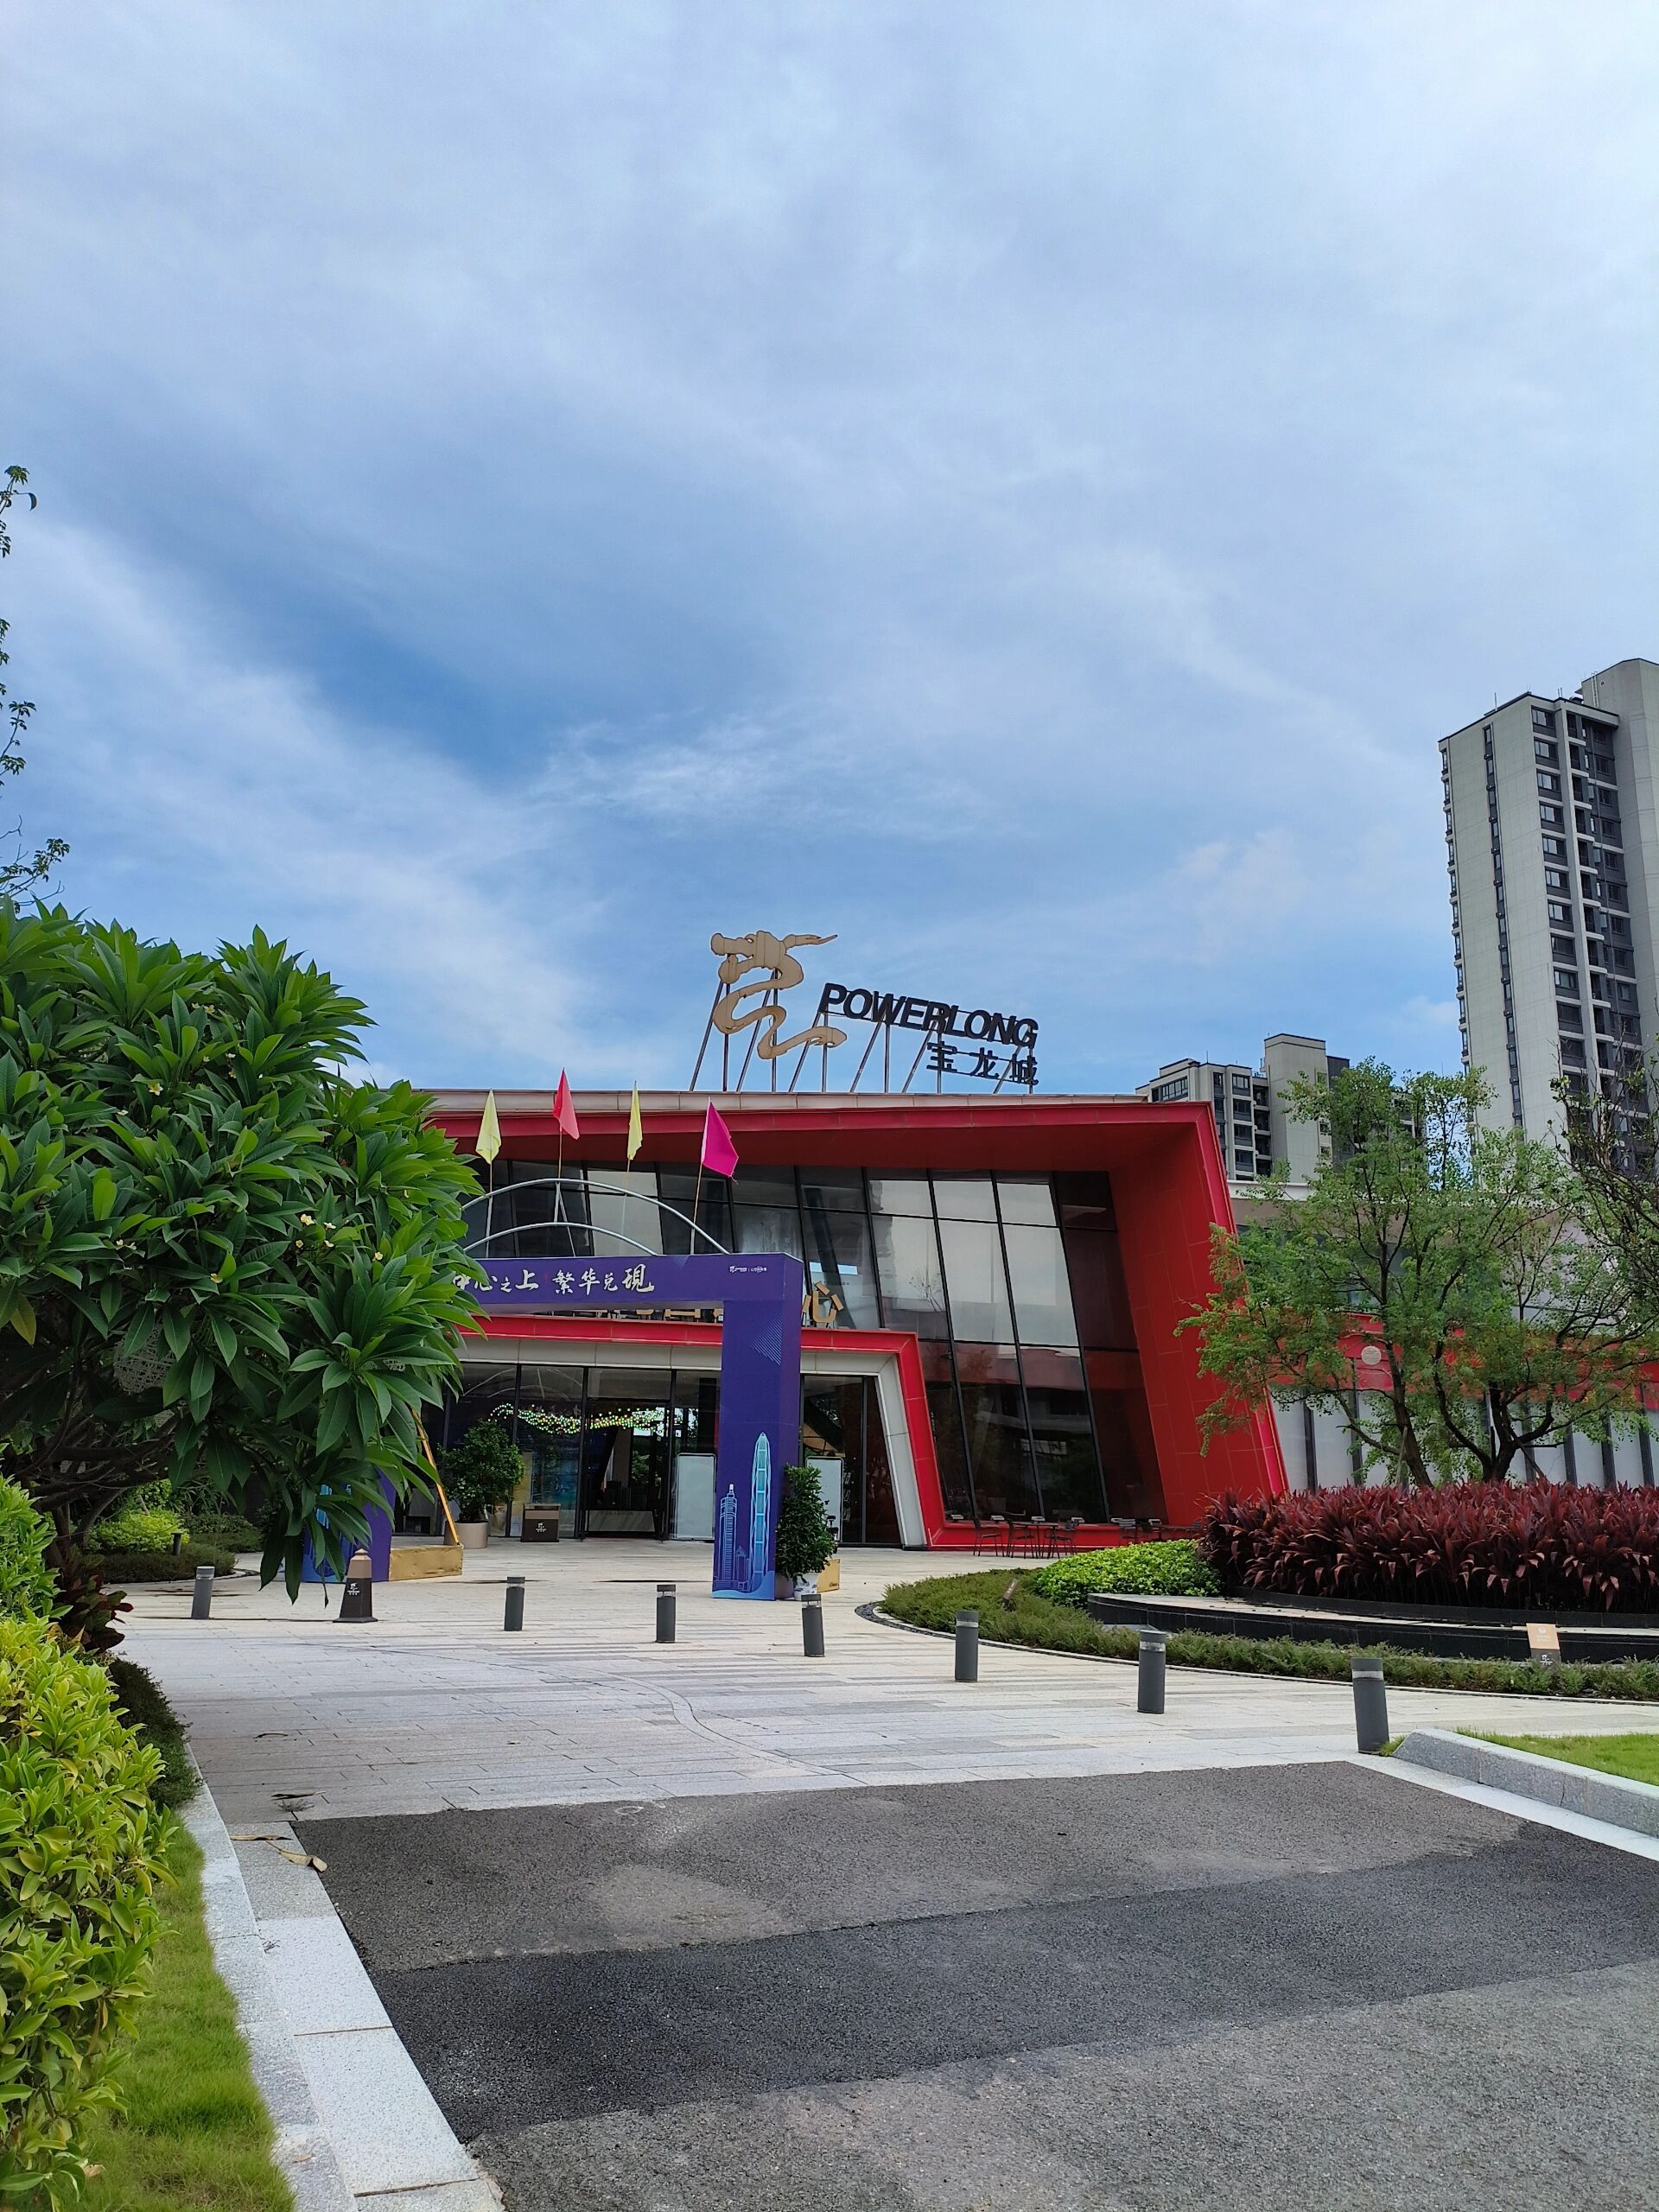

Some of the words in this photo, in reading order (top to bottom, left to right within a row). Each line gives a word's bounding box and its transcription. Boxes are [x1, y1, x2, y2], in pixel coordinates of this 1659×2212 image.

[820, 982, 1039, 1048] POWERLONG
[926, 1041, 1039, 1085] 宝龙城
